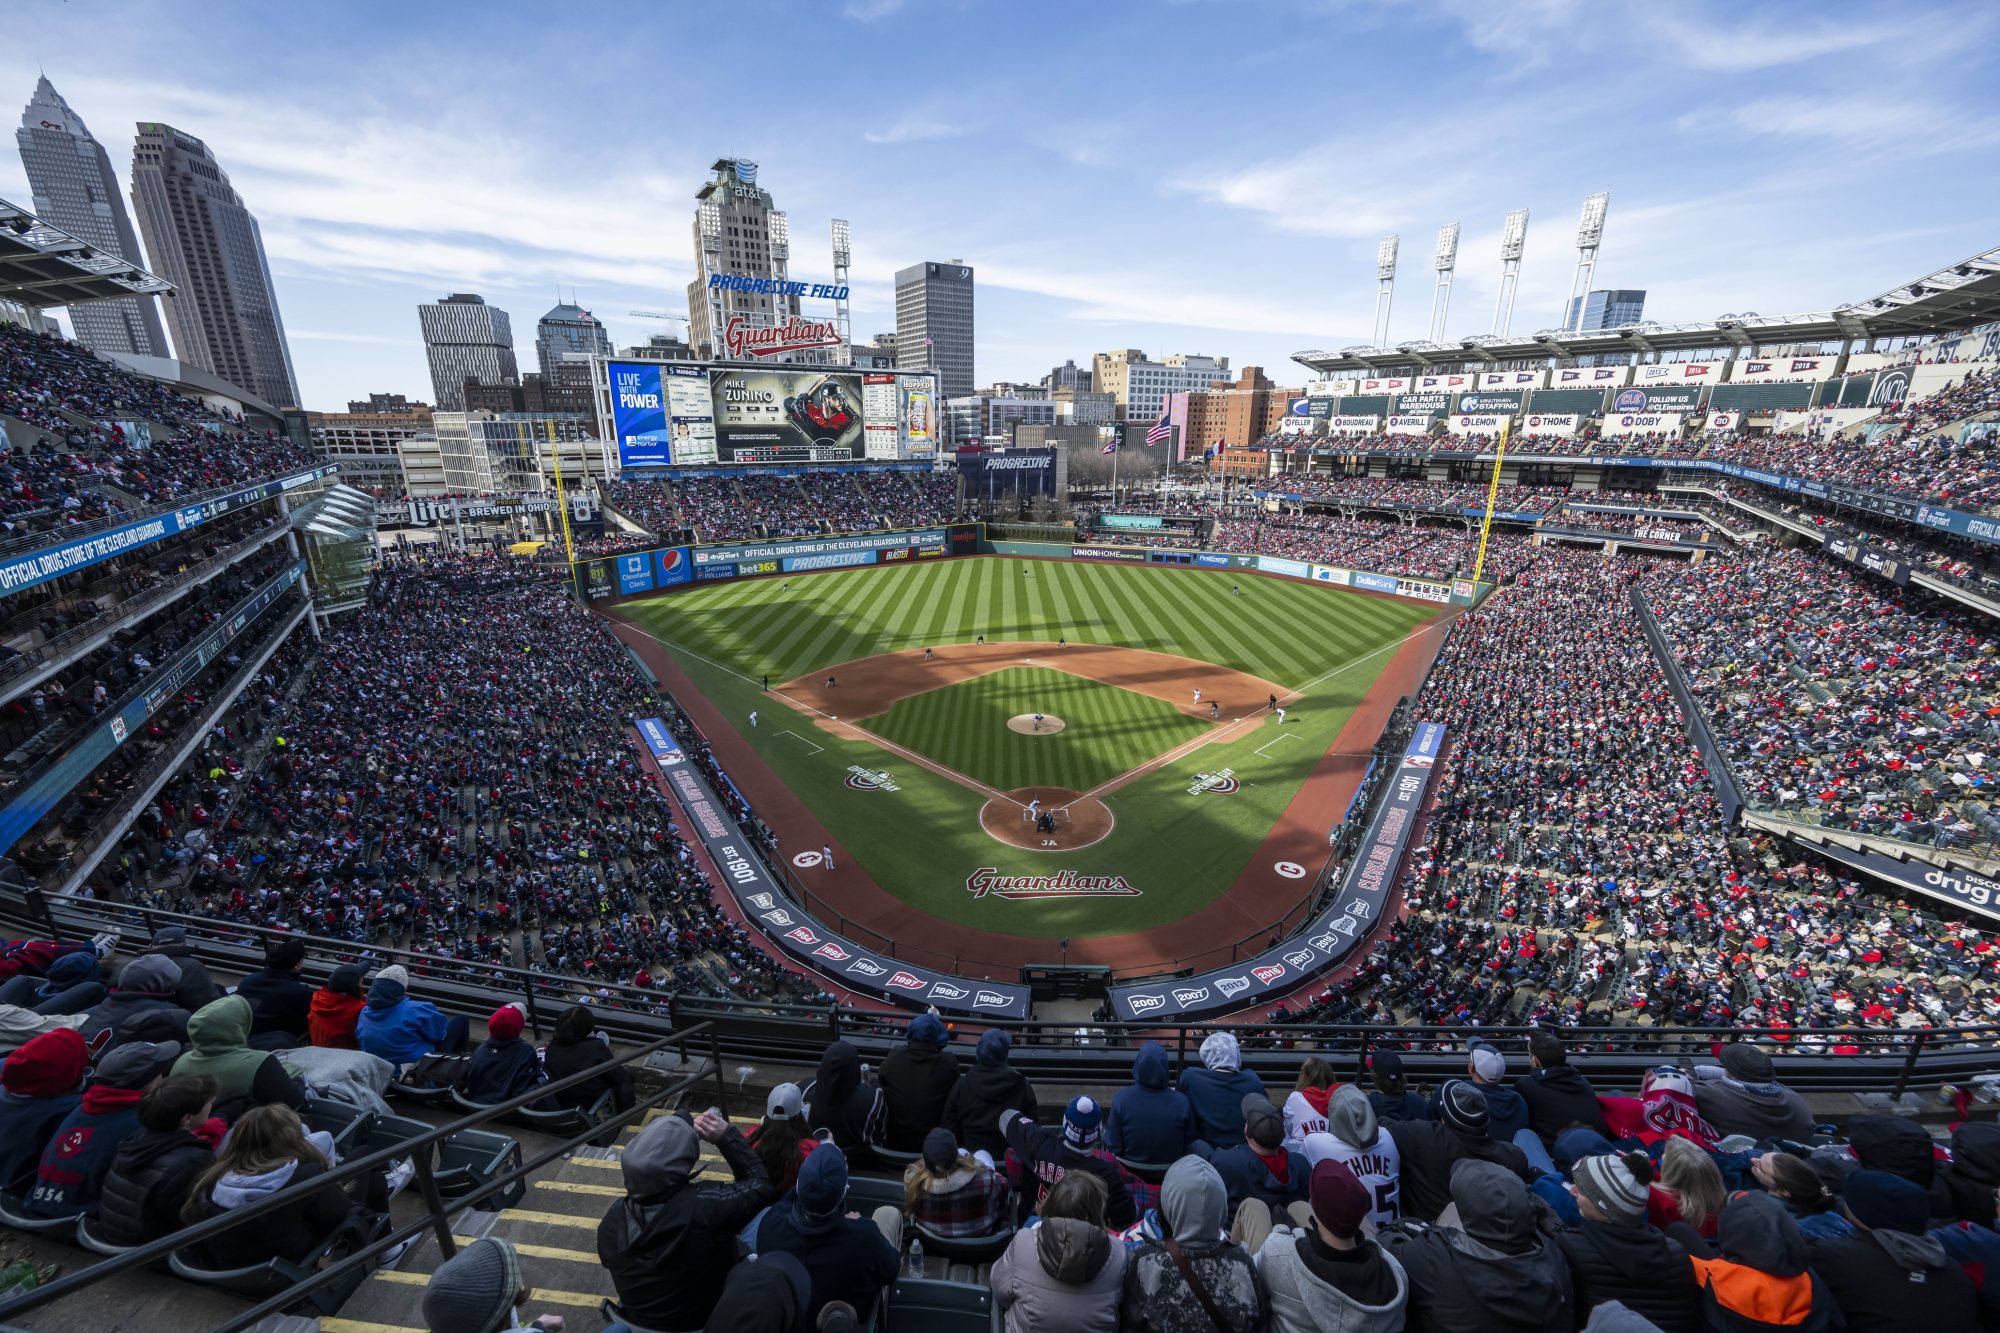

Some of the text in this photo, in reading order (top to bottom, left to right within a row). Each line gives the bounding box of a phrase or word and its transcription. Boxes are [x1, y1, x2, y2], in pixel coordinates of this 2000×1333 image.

[734, 187, 761, 200] at&t
[708, 274, 850, 300] PROGRESSIVE FIELD
[726, 316, 843, 357] Guardians
[1935, 339, 1962, 364] EST
[618, 373, 641, 386] LIVE
[725, 380, 746, 388] MIKE
[619, 386, 638, 394] WITH
[620, 394, 659, 408] POWER
[726, 391, 774, 402] ZUNINO
[1621, 394, 1641, 404] CLE
[1647, 403, 1695, 411] @CLEinspires
[1471, 418, 1496, 426] LEMON
[1542, 418, 1572, 426] THOME
[1636, 417, 1662, 426] DOBY
[985, 457, 1052, 470] PROGRESSIVE
[469, 502, 550, 517] BREWED IN OHIO
[575, 500, 588, 508] Lite
[408, 501, 450, 526] Lite
[1634, 528, 1681, 542] THE CORNER
[1968, 520, 1995, 538] OFFICIAL
[953, 532, 976, 542] meijer
[745, 549, 777, 558] OFFICIAL
[776, 547, 794, 556] DRUG
[796, 545, 816, 554] STORE
[838, 540, 872, 550] CLEVELAND
[874, 538, 906, 546] GUARDIANS
[0, 520, 164, 589] OFFICIAL DRUG STORE OF THE CLEVELAND GUARDIANS
[886, 550, 909, 560] BLASTER
[1199, 556, 1228, 564] FirstEnergy
[792, 552, 867, 570] PROGRESSIVE
[1260, 560, 1304, 574] PROGRESSIVE
[740, 562, 777, 574] bet365
[591, 570, 606, 580] 811
[622, 572, 650, 581] Cleveland
[667, 576, 684, 585] pepsi
[1356, 576, 1394, 589] DollarBank
[1456, 582, 1470, 592] drug
[1416, 593, 1442, 602] CLIFFS
[1400, 775, 1421, 792] 1901
[1398, 791, 1411, 802] EST.
[722, 846, 758, 884] EST. 1901
[1280, 864, 1300, 875] C
[966, 868, 1143, 900] Guardians
[1924, 870, 1990, 905] drug
[756, 894, 770, 906] 1920
[1353, 903, 1367, 916] 2022
[770, 910, 787, 924] 1948
[1337, 918, 1354, 931] 2020
[794, 929, 812, 942] 1954
[1316, 936, 1335, 949] 2018
[822, 946, 843, 959] 1995
[1290, 953, 1311, 965] 2017
[856, 961, 879, 974] 1996
[1258, 968, 1281, 980] 2016
[894, 975, 918, 987] 1997
[1220, 980, 1245, 991] 2013
[935, 986, 960, 997] 1998
[1178, 992, 1204, 1001] 2007
[979, 995, 1004, 1004] 1999
[1133, 998, 1158, 1007] 2001
